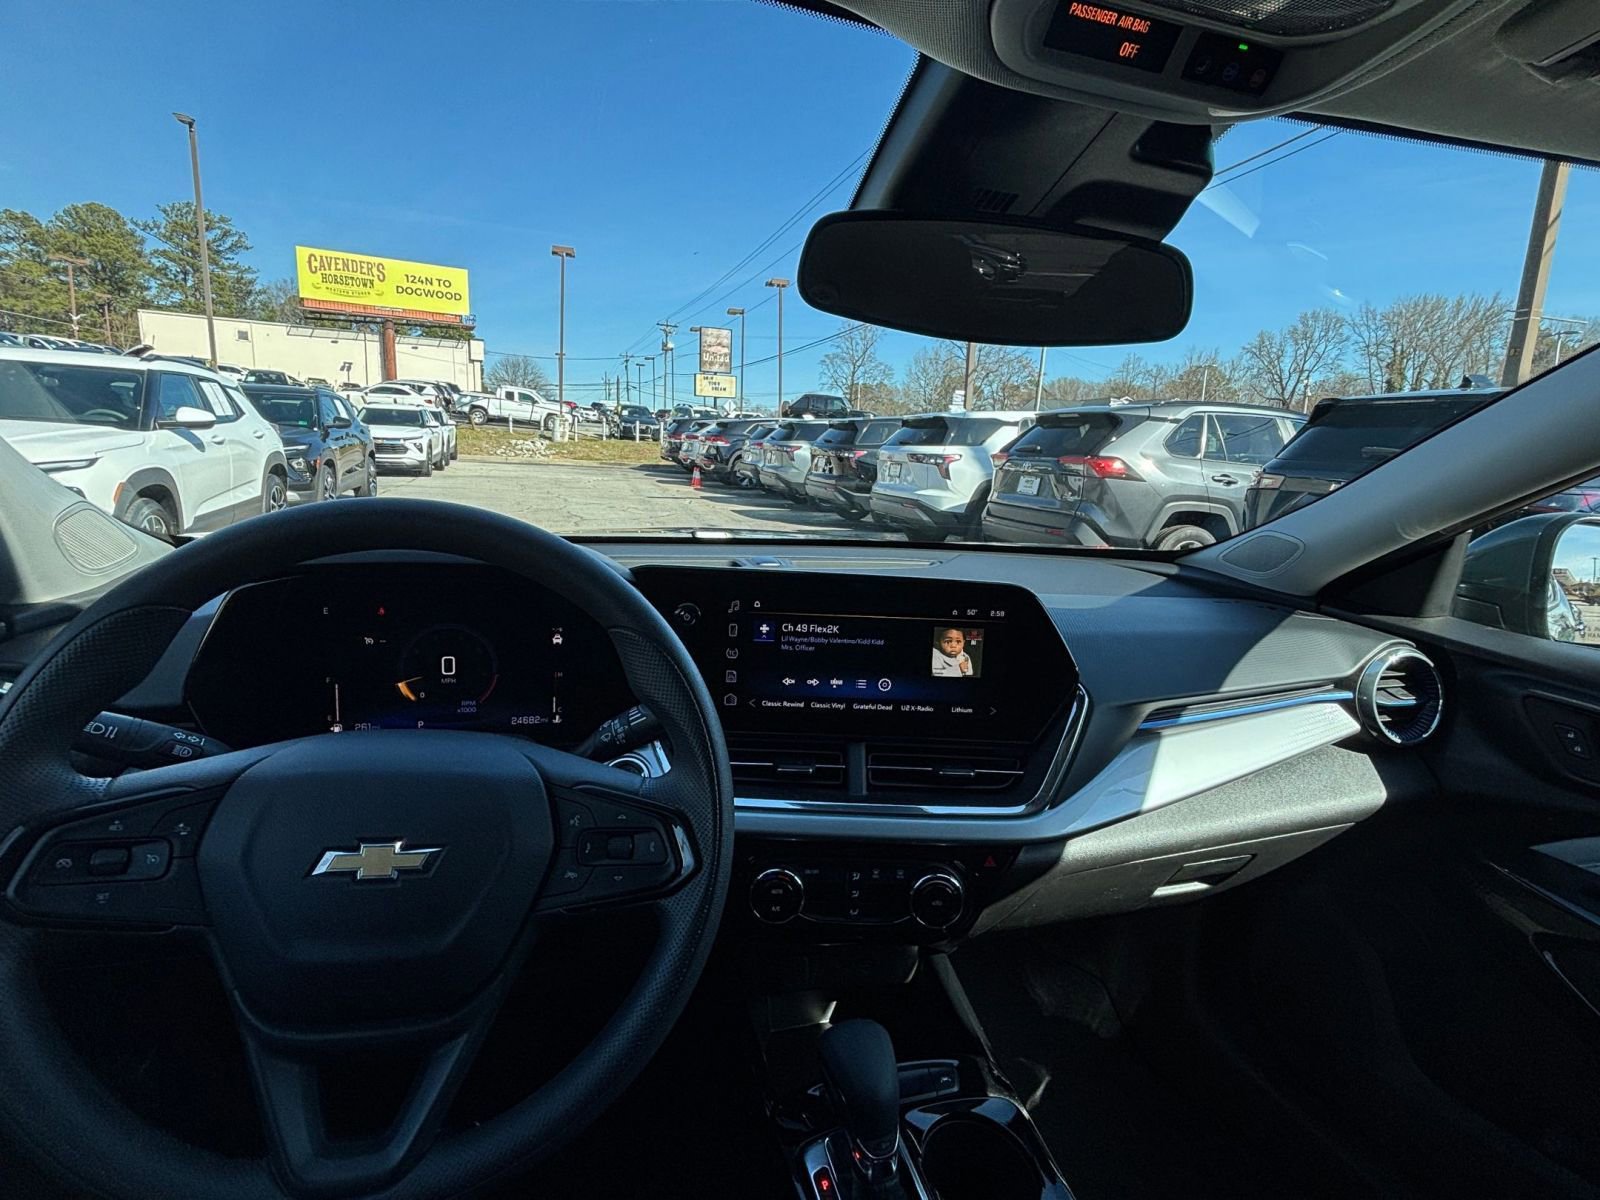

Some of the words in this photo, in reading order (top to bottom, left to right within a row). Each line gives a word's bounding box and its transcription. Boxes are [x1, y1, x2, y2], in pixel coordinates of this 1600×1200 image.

[1069, 2, 1118, 26] PASSENGER
[1117, 15, 1134, 29] AIR
[1133, 18, 1151, 33] BAG
[1120, 41, 1140, 58] OFF
[307, 253, 386, 283] CAVENDER'S
[321, 273, 375, 289] HORSETOWN
[404, 274, 433, 286] 124N
[435, 278, 452, 288] TO
[396, 285, 463, 301] DOGWOOD
[323, 607, 329, 615] E
[781, 623, 794, 632] Ch
[795, 624, 808, 633] 49
[809, 624, 840, 634] Flex2K
[795, 644, 816, 652] Officer
[441, 656, 456, 676] 0
[810, 701, 831, 709] Classic
[831, 702, 846, 710] Vinyl
[877, 703, 893, 711] Dead
[911, 704, 934, 712] X-Radio
[417, 720, 425, 729] P
[821, 1180, 829, 1190] P
